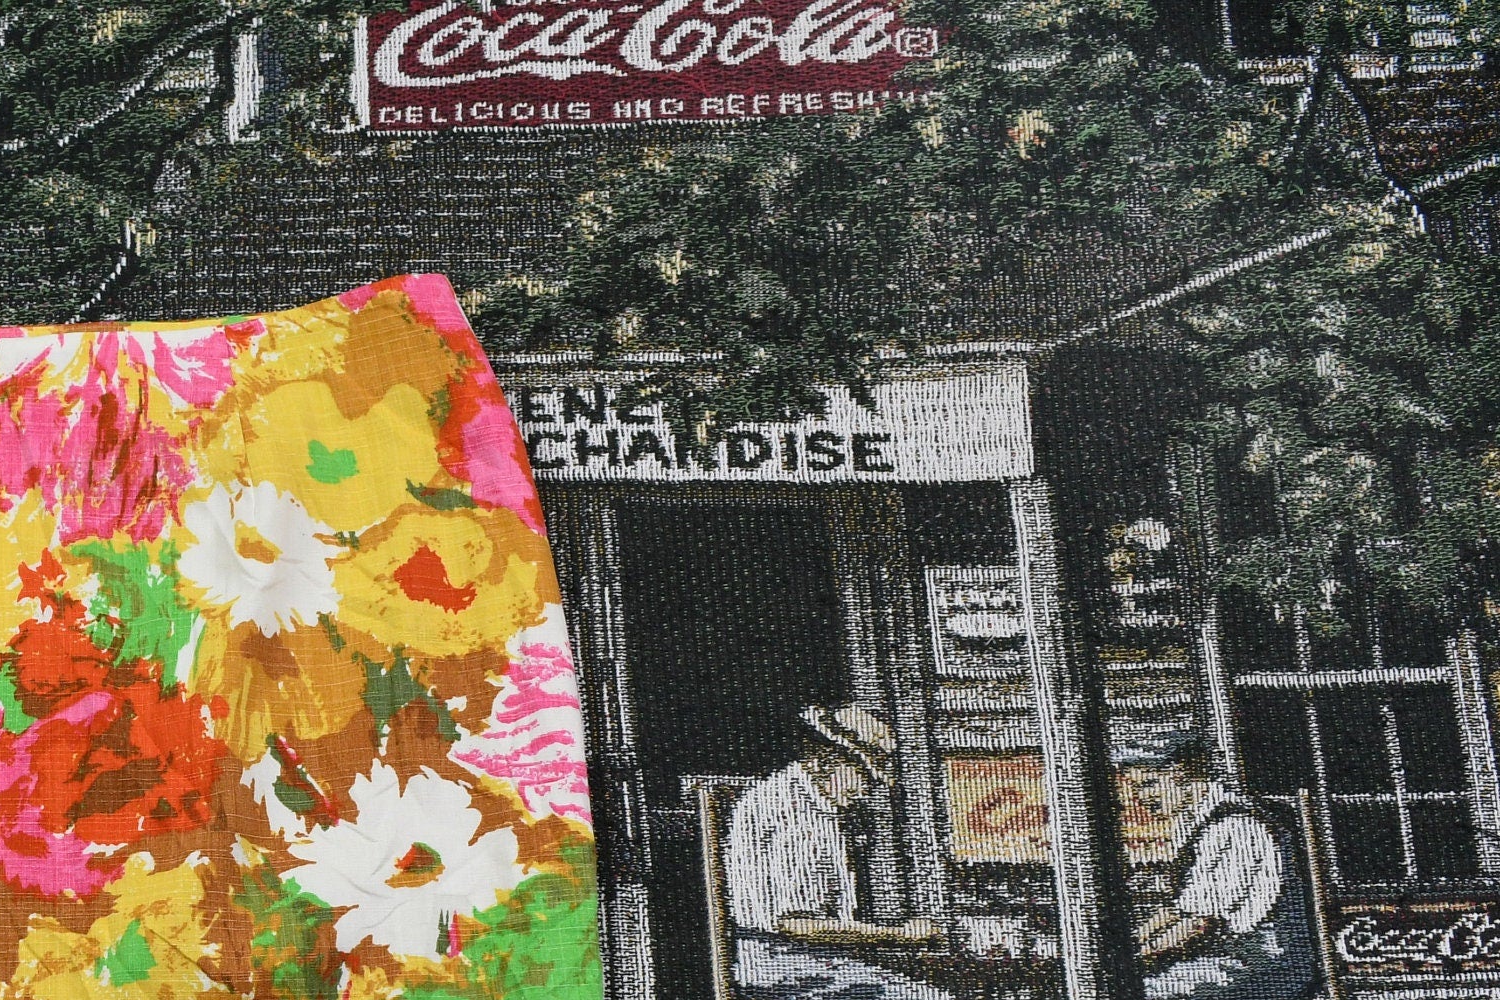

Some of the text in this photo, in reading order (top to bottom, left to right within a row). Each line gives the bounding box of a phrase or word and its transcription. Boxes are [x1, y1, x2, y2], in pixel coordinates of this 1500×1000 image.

[374, 0, 896, 87] Coca-Cola
[378, 91, 946, 124] DELICIOUS AND REFRESH
